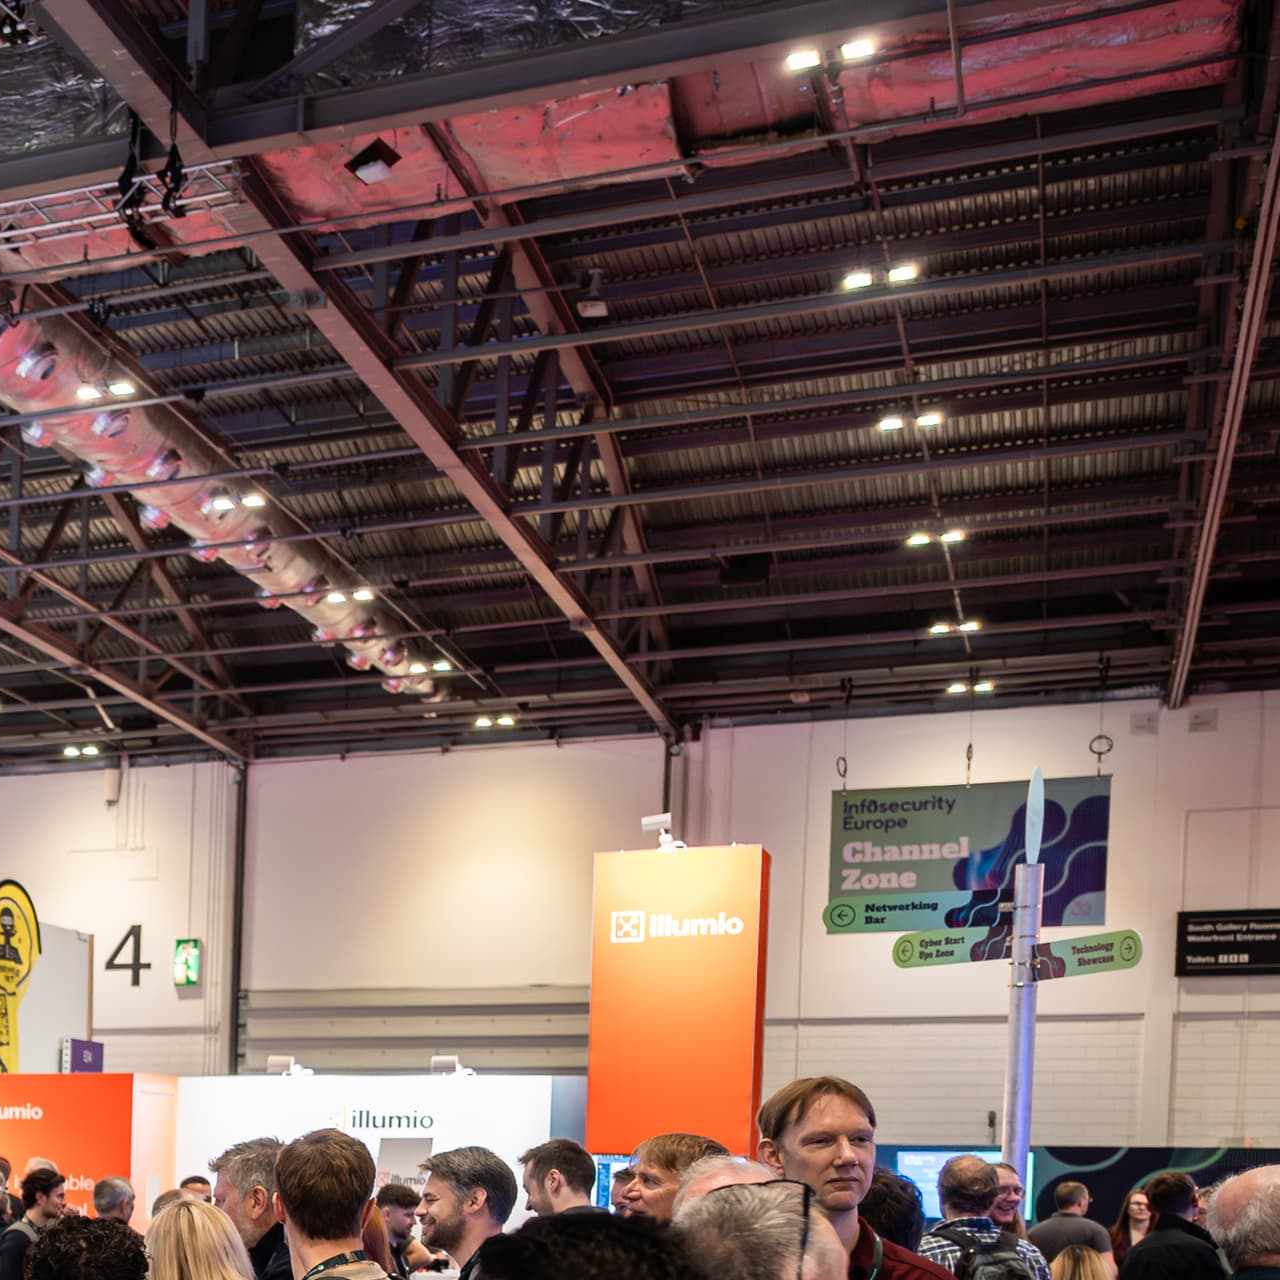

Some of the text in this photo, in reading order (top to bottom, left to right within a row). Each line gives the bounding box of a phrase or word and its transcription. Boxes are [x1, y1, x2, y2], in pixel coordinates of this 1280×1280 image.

[842, 795, 957, 815] Infosecurity
[842, 815, 908, 834] Europe
[842, 836, 970, 864] Channel
[841, 868, 917, 891] Zone
[864, 901, 939, 914] Networking
[649, 912, 745, 938] illumio
[864, 915, 886, 925] Bar
[919, 935, 965, 949] Cyber Start
[1072, 940, 1115, 956] Technology
[105, 925, 151, 987] 4
[919, 948, 955, 961] Ups Zone
[1077, 954, 1115, 967] Showcase
[352, 1110, 434, 1129] illumio
[391, 1174, 426, 1186] illumio
